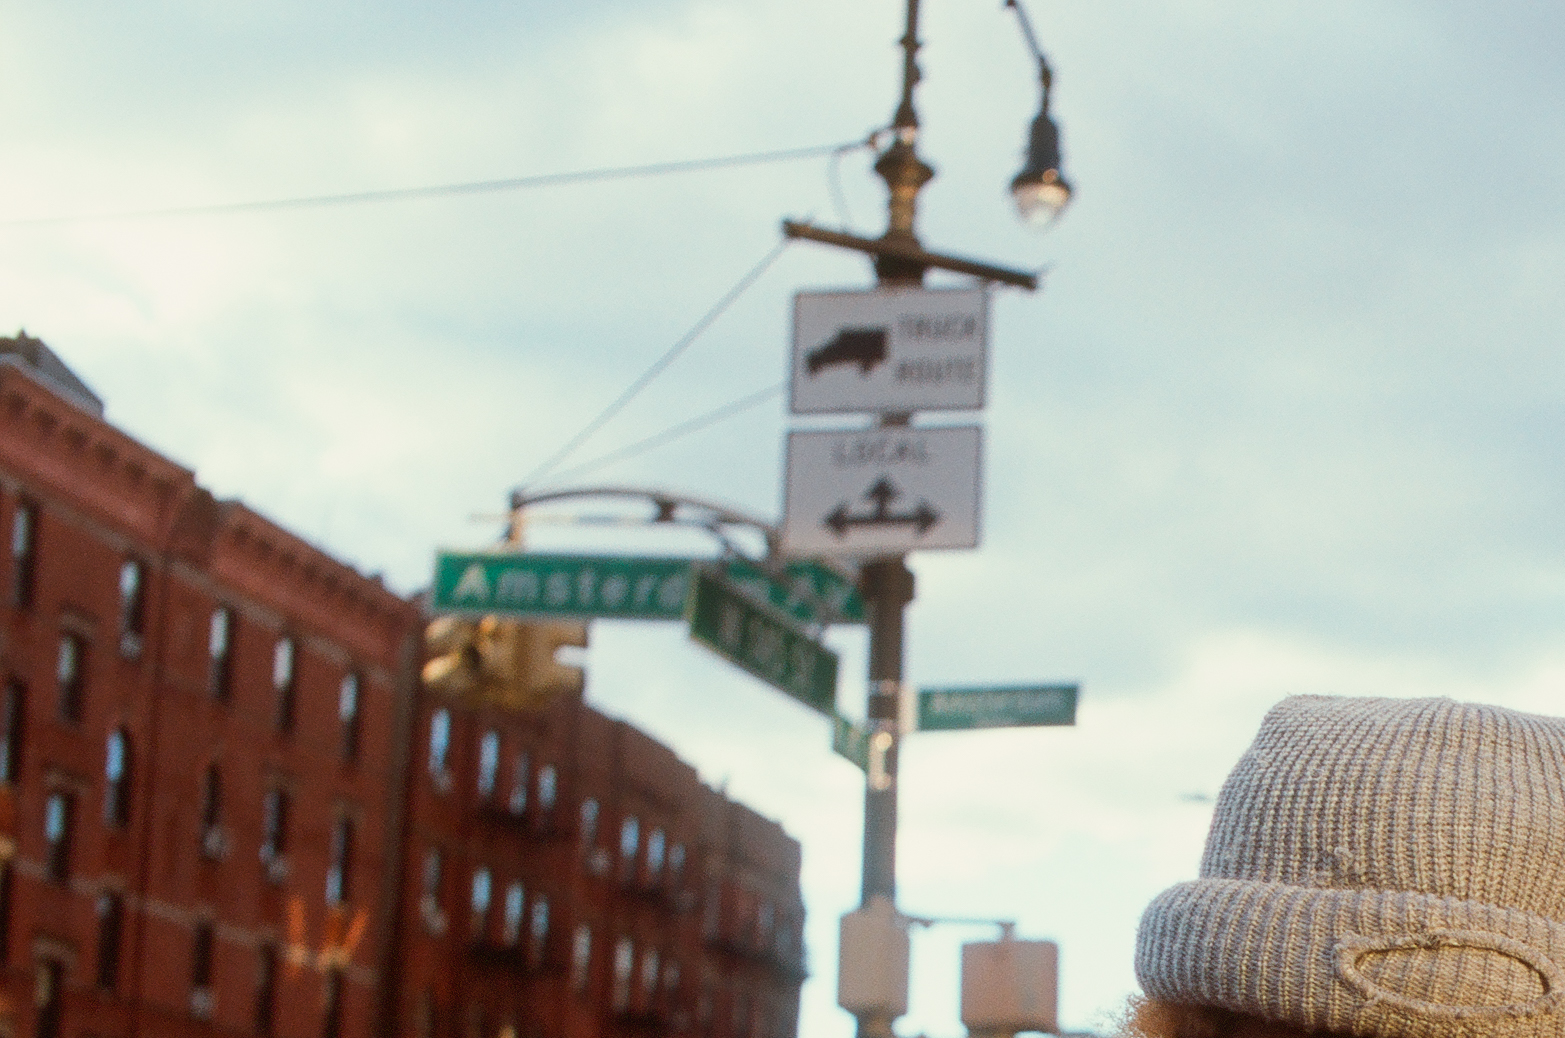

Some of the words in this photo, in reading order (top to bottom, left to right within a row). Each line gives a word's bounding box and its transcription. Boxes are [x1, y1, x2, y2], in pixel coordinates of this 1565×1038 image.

[898, 313, 976, 340] TRUCK
[896, 358, 975, 384] ROUTE
[831, 437, 929, 466] LOCAL
[452, 562, 774, 607] Amsterd
